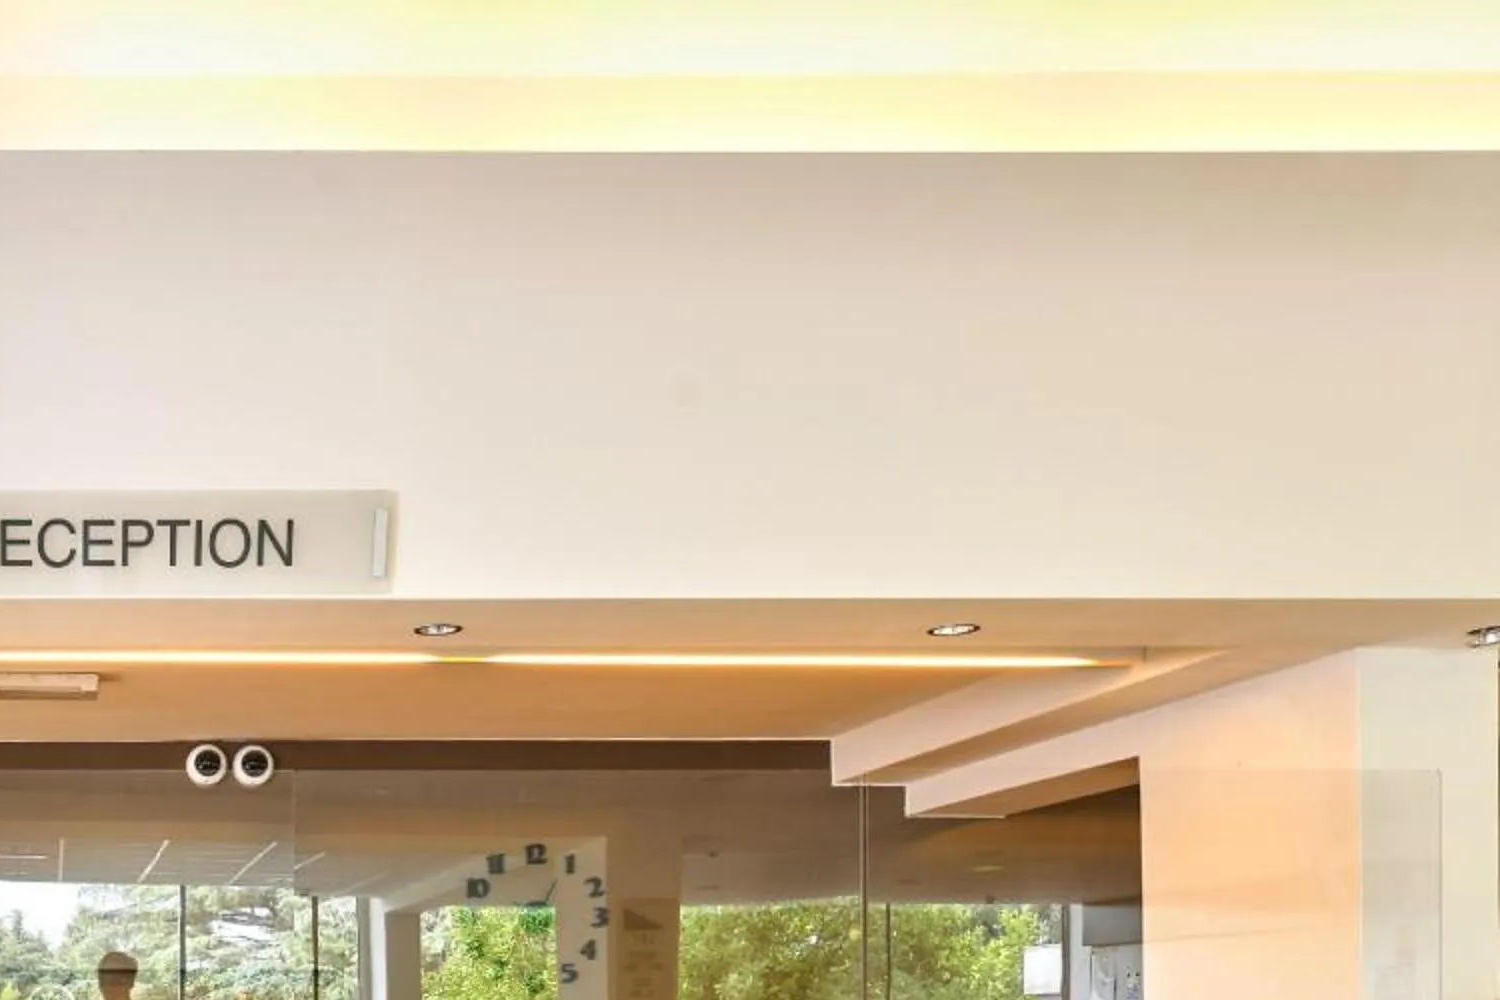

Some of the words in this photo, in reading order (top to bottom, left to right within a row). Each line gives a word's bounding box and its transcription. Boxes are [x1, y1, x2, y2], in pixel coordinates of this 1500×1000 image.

[525, 843, 548, 865] 12
[564, 854, 576, 874] 1
[466, 877, 491, 898] 10
[584, 876, 605, 898] 2
[591, 907, 610, 928] 3
[580, 939, 596, 960] 4
[561, 963, 579, 983] 5
